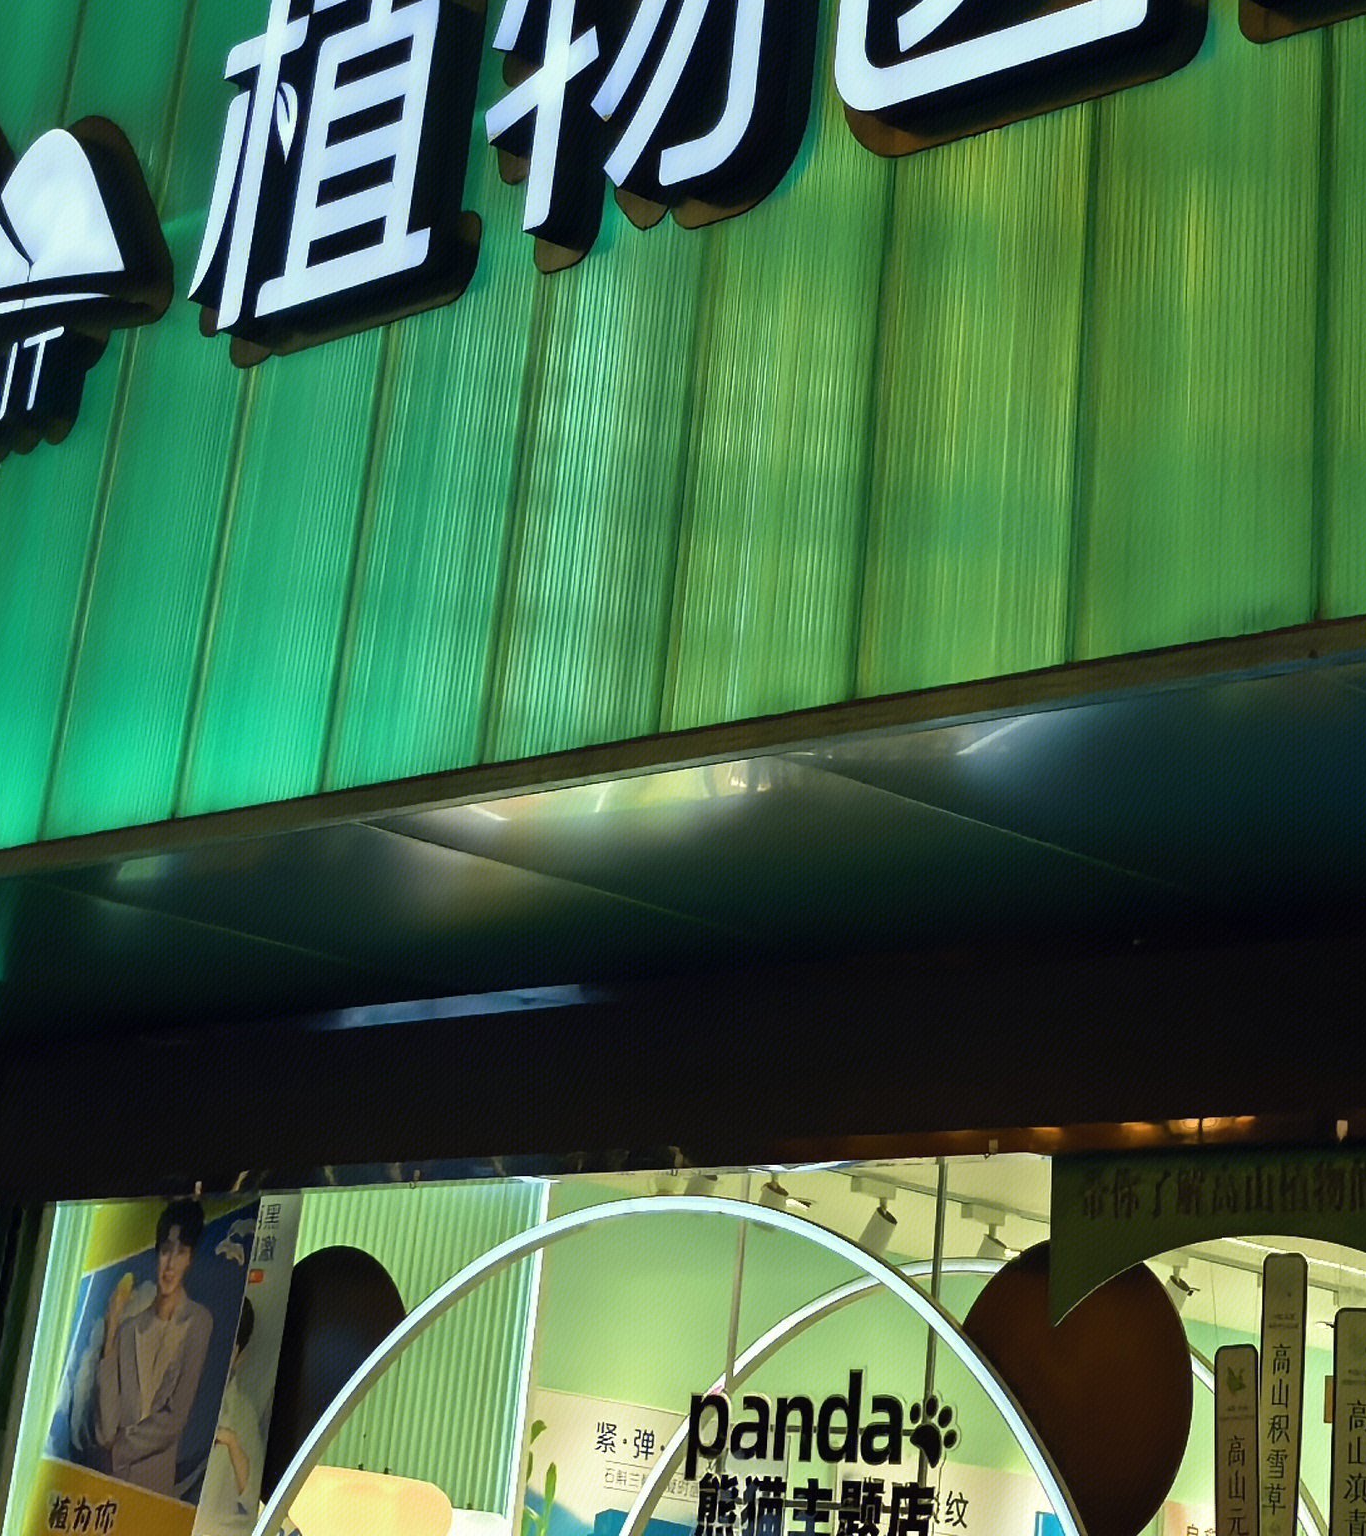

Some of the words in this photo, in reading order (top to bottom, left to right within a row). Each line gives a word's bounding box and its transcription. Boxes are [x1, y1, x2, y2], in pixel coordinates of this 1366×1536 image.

[684, 1368, 903, 1481] panda
[1263, 1343, 1292, 1516] 高山积雪草
[48, 1494, 118, 1535] 植为你
[695, 1472, 935, 1536] 熊猫主题店
[934, 1489, 970, 1529] 纹
